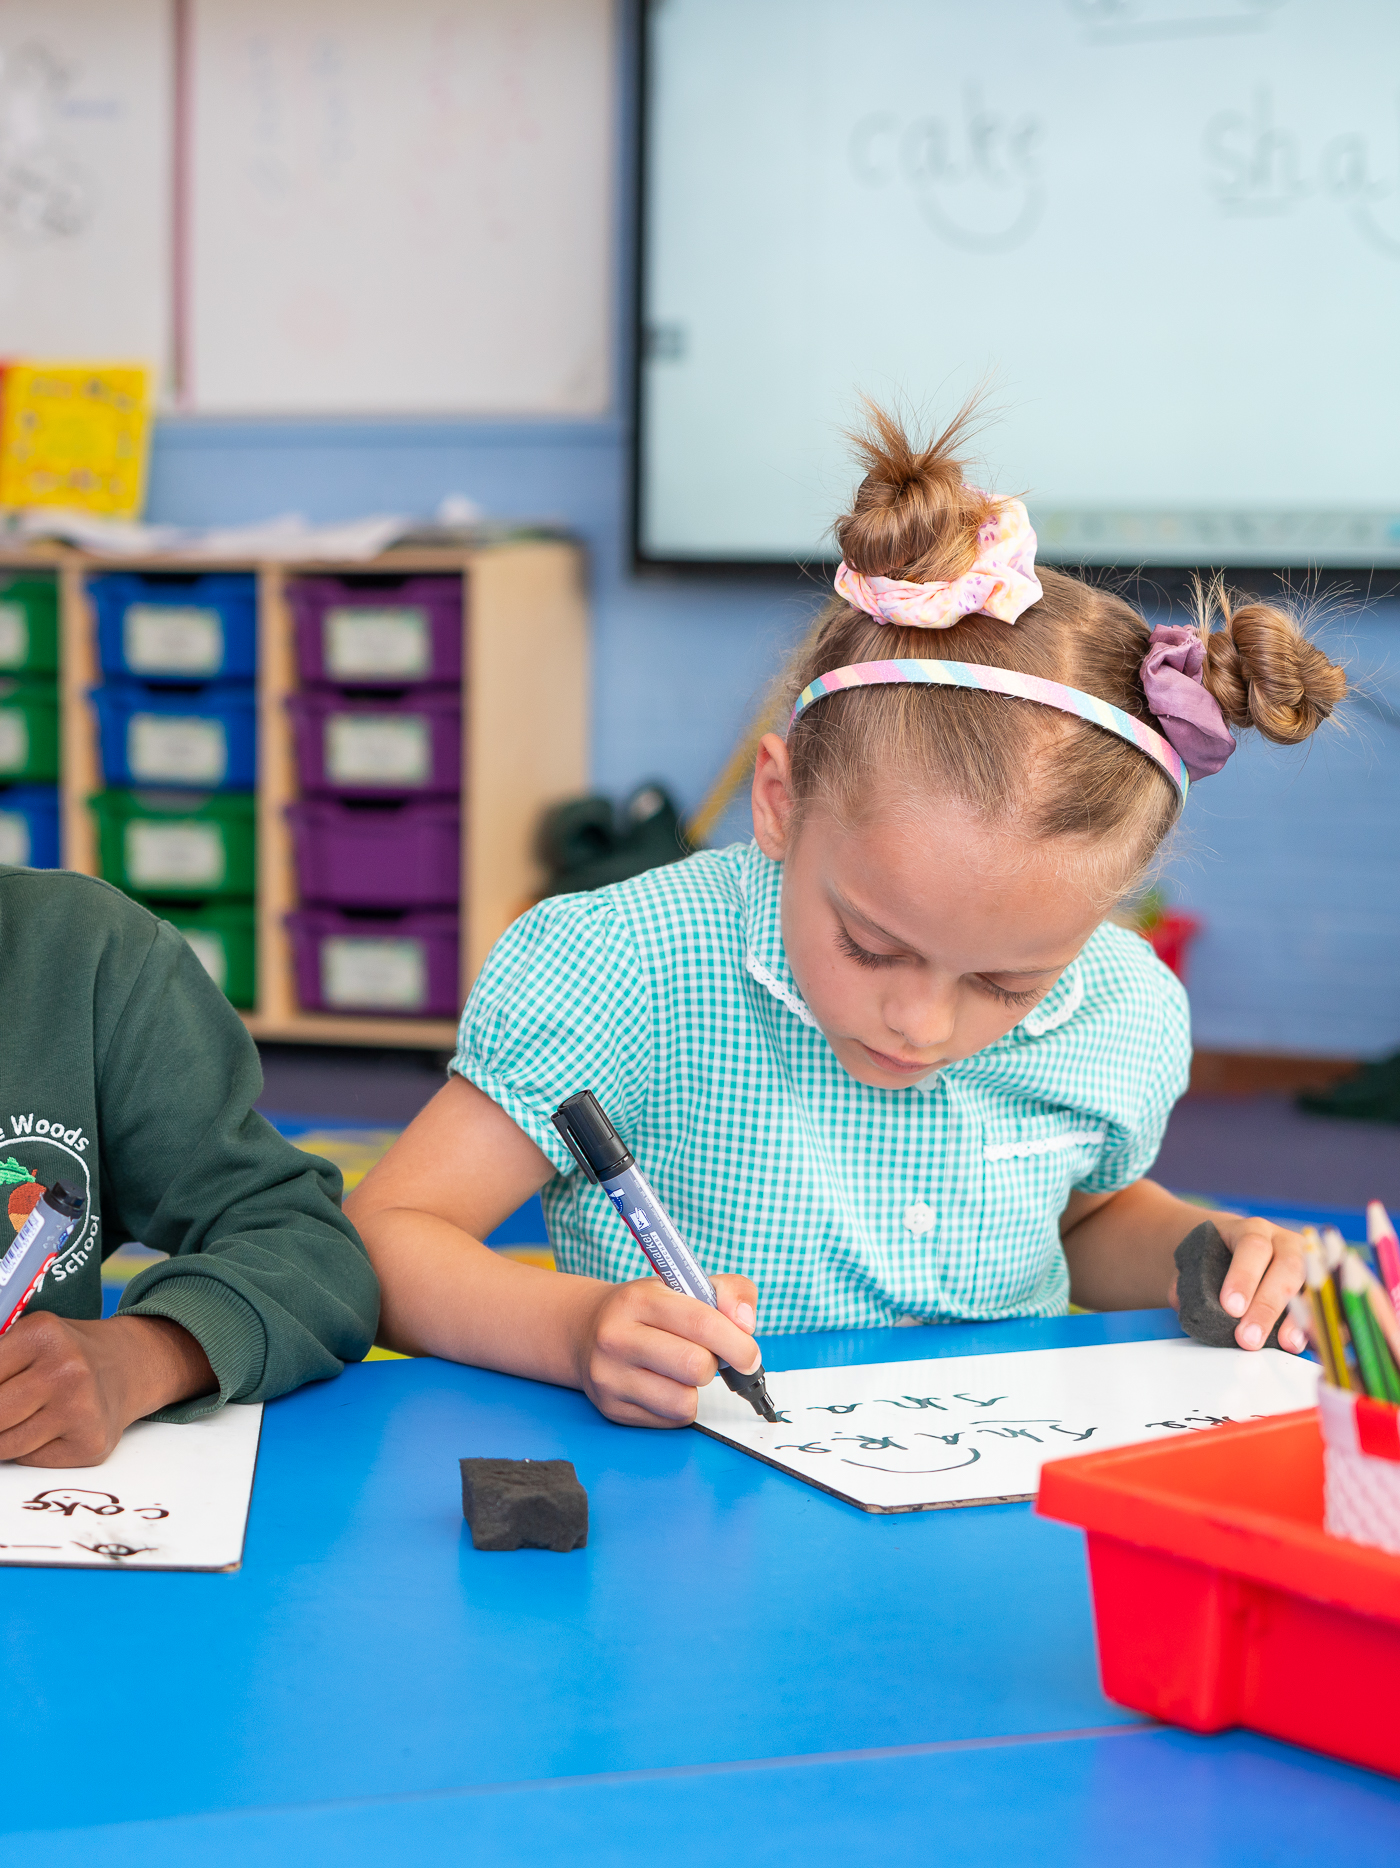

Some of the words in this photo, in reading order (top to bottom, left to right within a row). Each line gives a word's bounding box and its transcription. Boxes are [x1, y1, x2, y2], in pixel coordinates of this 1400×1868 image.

[1202, 78, 1400, 202] sha
[10, 1113, 89, 1152] Woods
[51, 1215, 99, 1281] School
[639, 1230, 664, 1269] marker
[661, 1269, 685, 1296] oard
